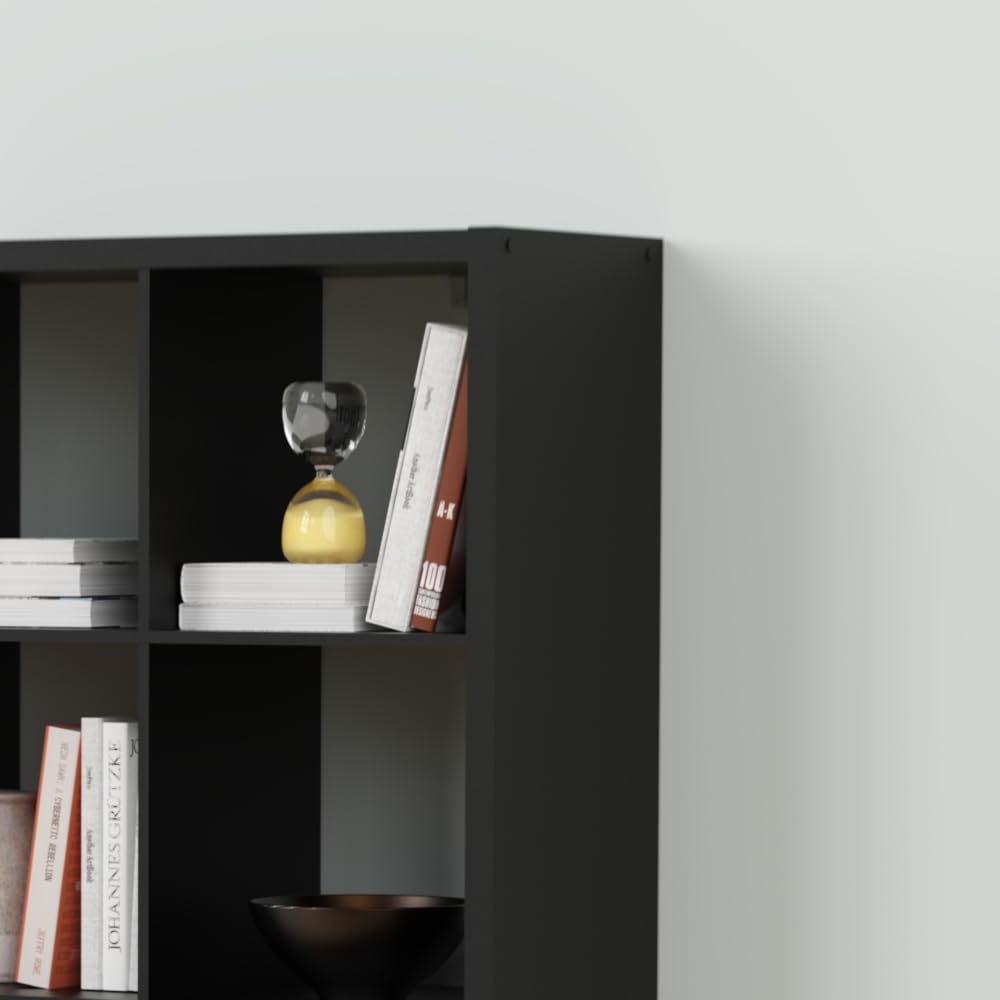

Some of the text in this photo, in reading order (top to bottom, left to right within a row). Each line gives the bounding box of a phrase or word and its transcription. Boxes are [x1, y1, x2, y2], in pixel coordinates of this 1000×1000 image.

[420, 560, 447, 593] 100
[45, 843, 57, 881] REBELLION
[107, 743, 121, 952] JOHANNES GRÜTZKE
